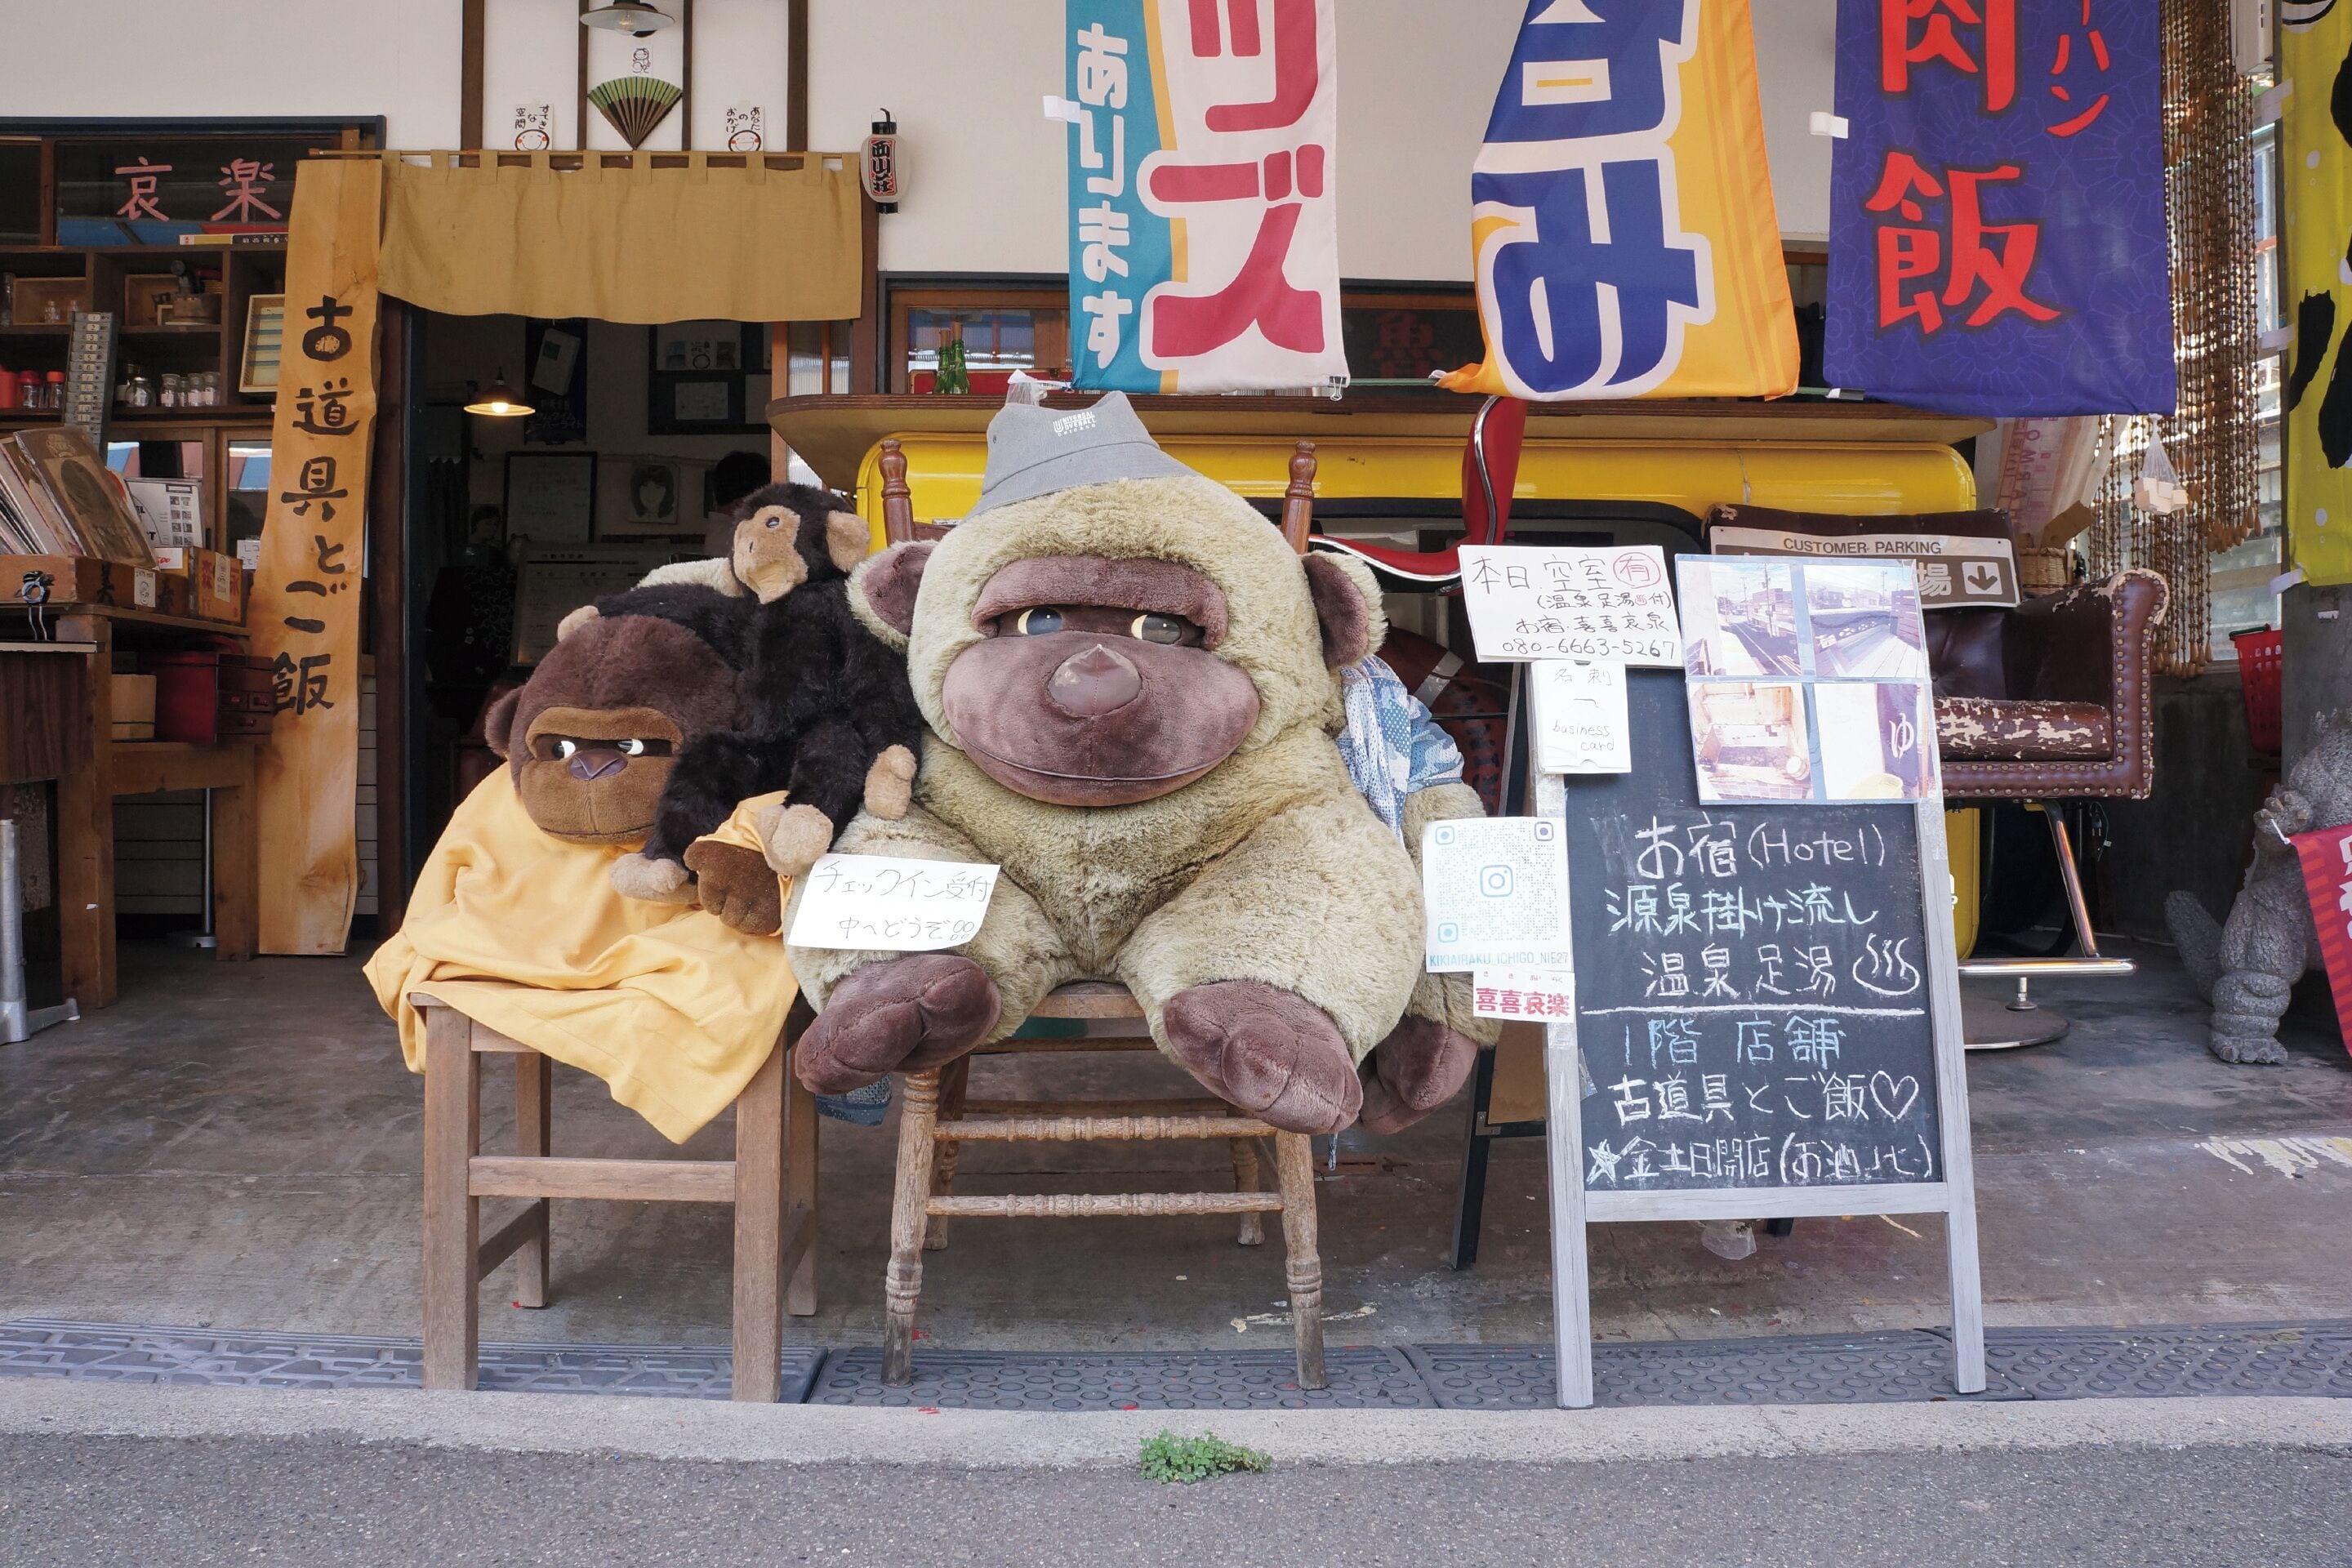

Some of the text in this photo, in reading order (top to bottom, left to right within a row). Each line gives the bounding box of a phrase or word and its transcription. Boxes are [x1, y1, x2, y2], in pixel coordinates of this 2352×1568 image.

[1076, 22, 1134, 369] あります
[1783, 537, 1942, 555] CUSTOMER PARKING
[1502, 638, 1675, 660] 080-6663-5267
[1552, 719, 1610, 737] business
[1889, 712, 1915, 760] ゆ
[1580, 738, 1615, 752] card
[814, 860, 991, 902] チェックイン受付
[1604, 881, 1879, 939] 源泉掛け流し
[838, 915, 950, 940] 中へどうぞ
[1475, 987, 1570, 1018] 喜喜哀楽
[1607, 1071, 1870, 1126] 古道具とご飯
